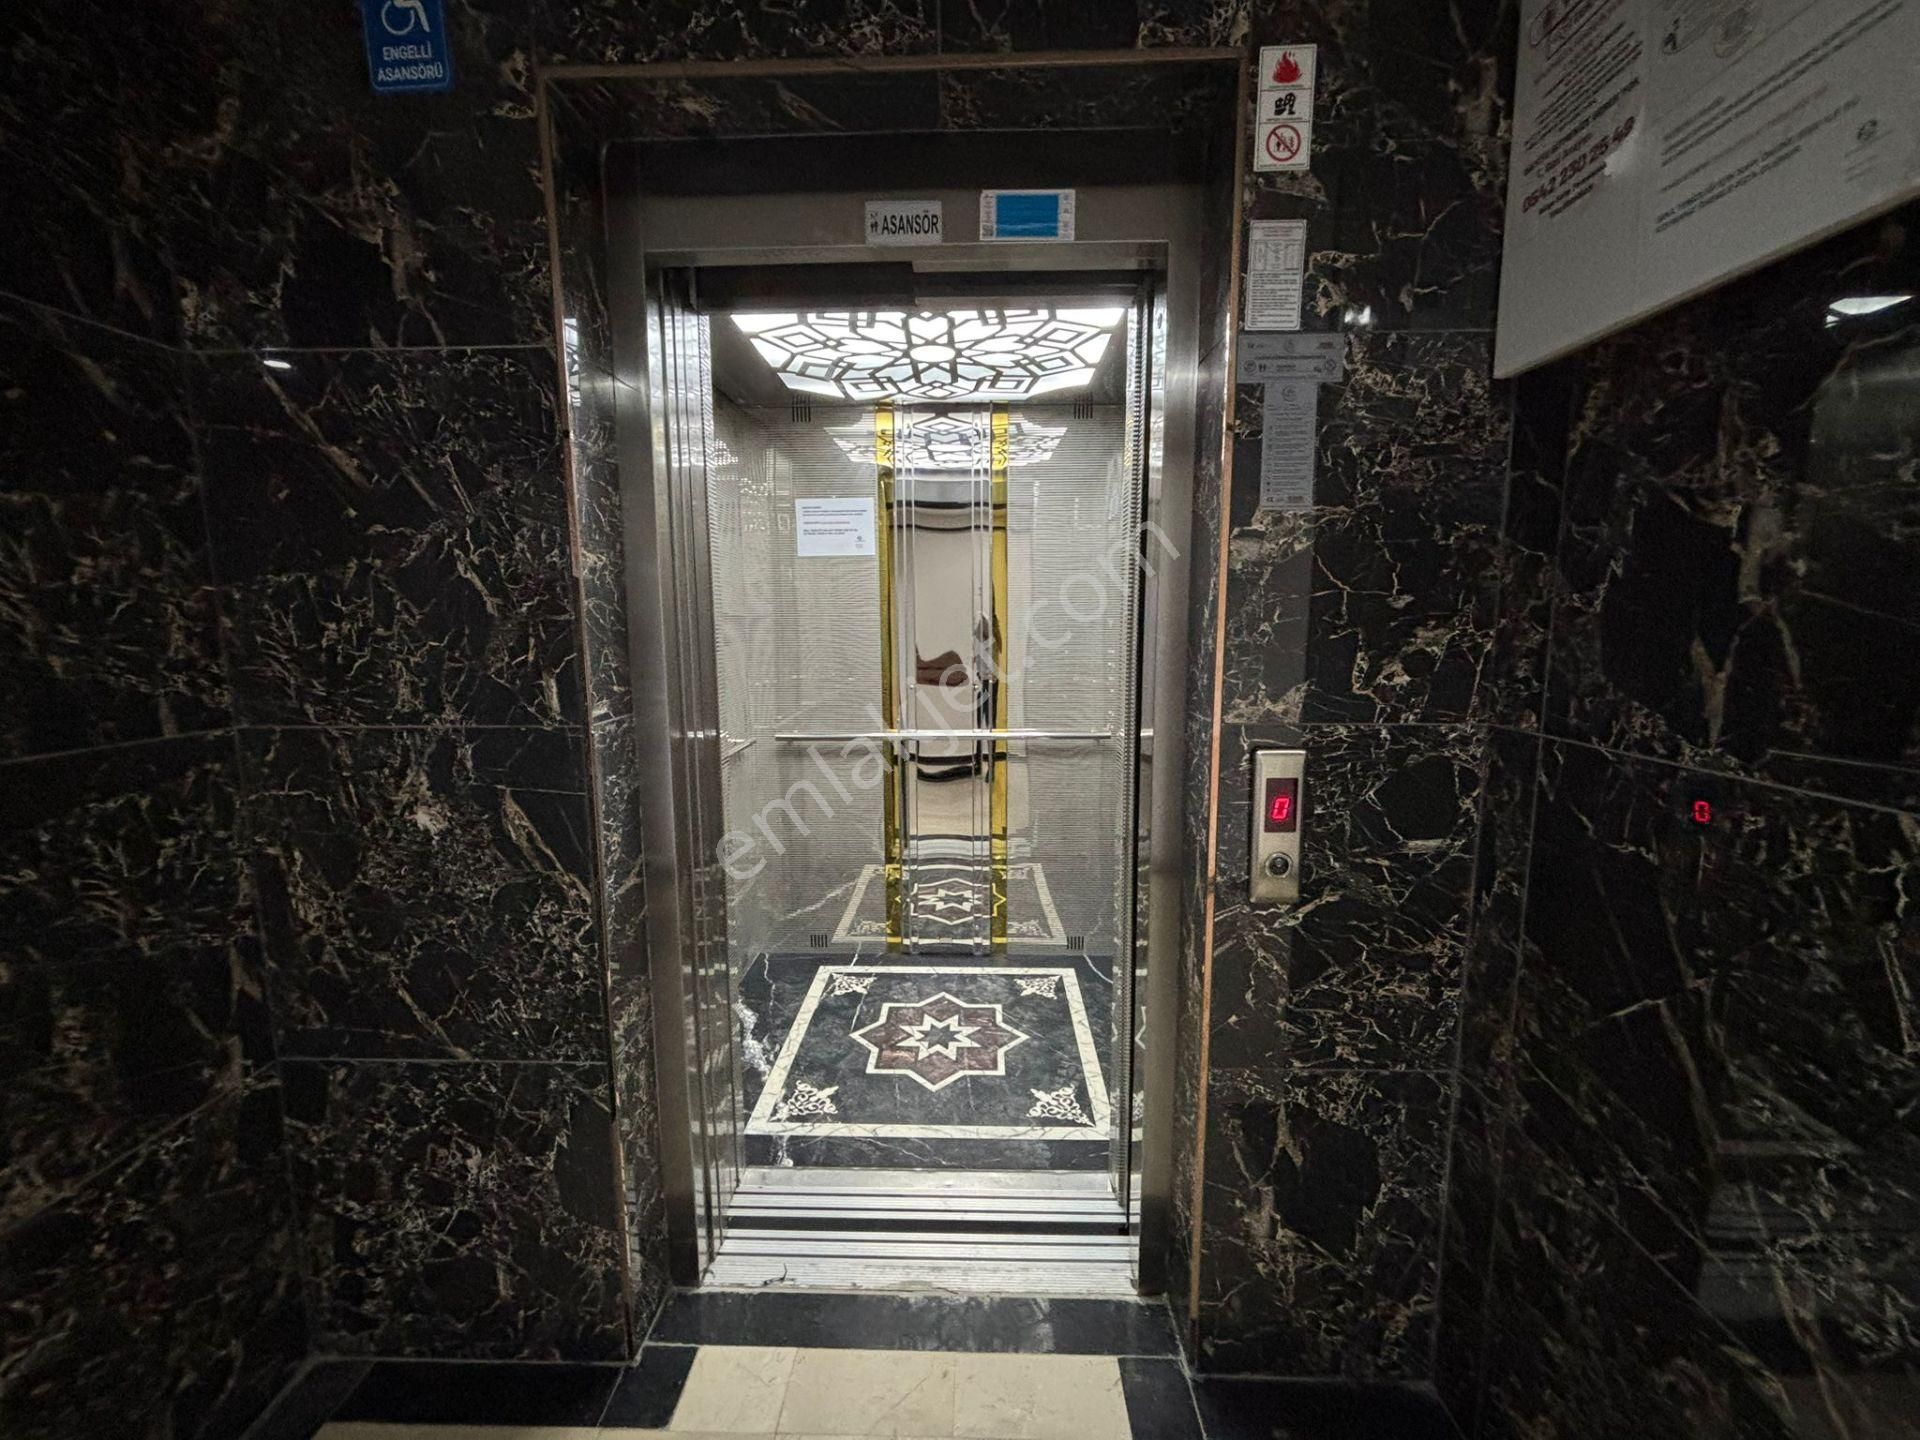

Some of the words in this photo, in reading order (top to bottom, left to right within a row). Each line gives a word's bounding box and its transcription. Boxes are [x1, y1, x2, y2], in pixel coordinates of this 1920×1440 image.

[382, 41, 432, 61] ENGELLİ
[377, 61, 443, 81] ASANSÖRÜ
[881, 209, 939, 235] ASANSÖR
[1271, 797, 1290, 820] 0
[1694, 800, 1711, 823] 0
